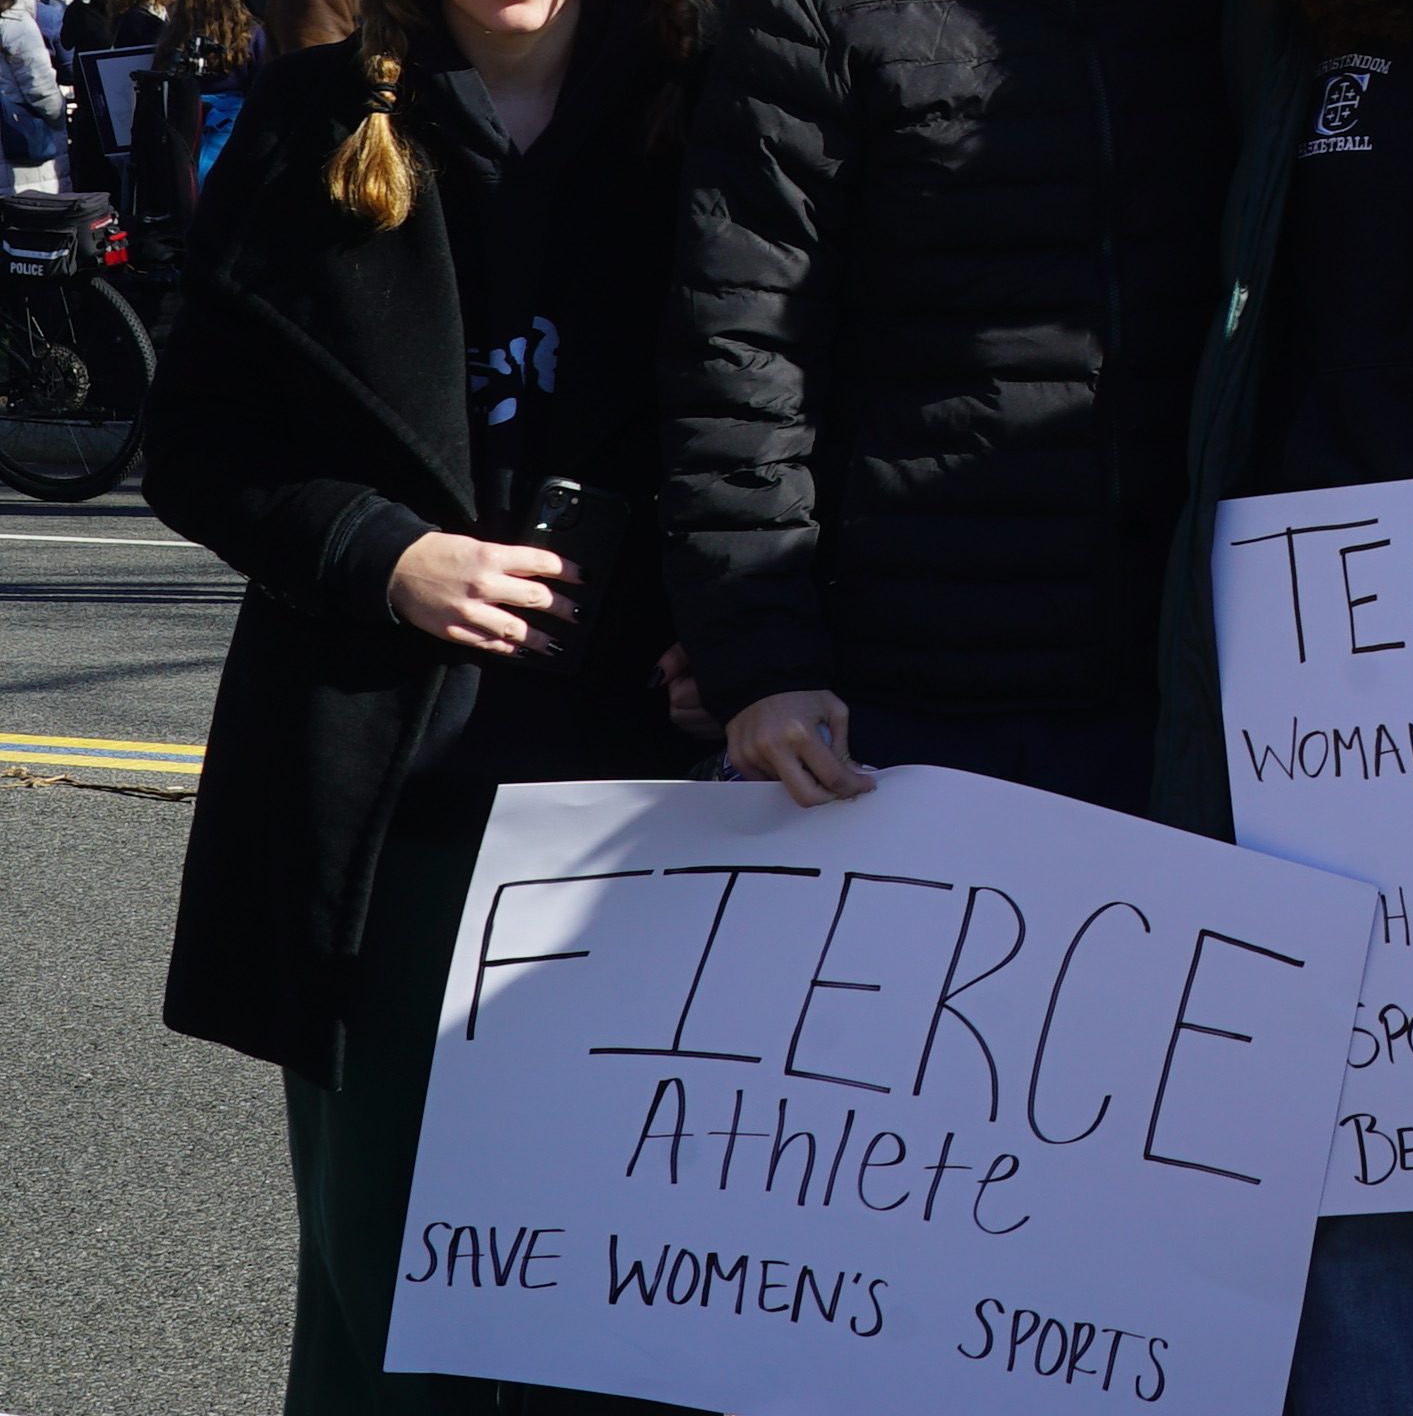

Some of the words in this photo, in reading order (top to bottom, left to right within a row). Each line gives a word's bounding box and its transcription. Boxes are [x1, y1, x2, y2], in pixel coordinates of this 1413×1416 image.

[1312, 52, 1393, 77] RISTENDOM
[1297, 135, 1374, 160] SKETBALL
[10, 262, 44, 276] POLICE
[465, 865, 1306, 1185] FIERCE
[624, 1076, 1031, 1235] Athlete
[404, 1219, 567, 1291] SAVE
[607, 1233, 890, 1338] WOMEN'S
[956, 1297, 1170, 1403] SPORTS
